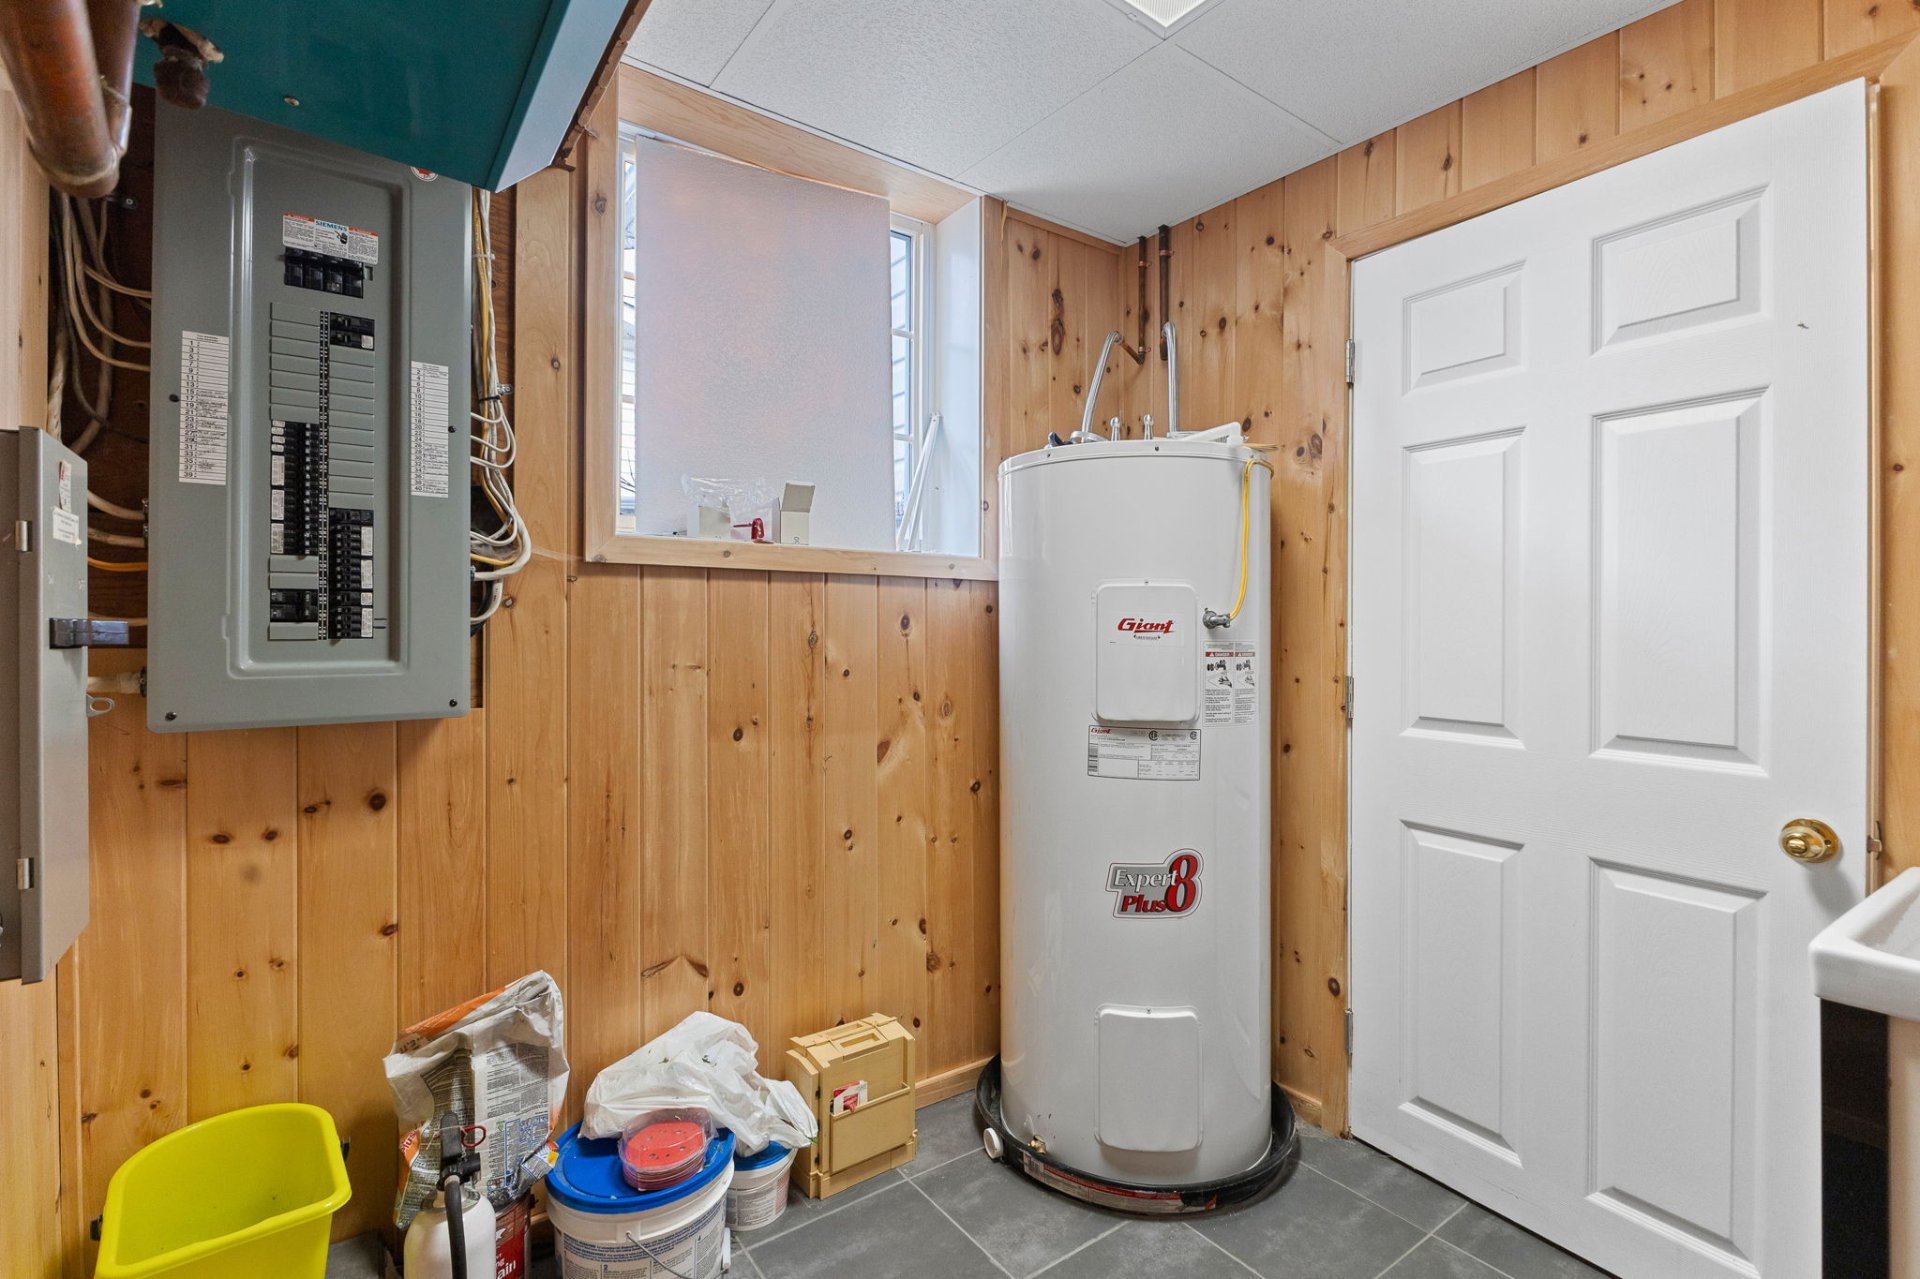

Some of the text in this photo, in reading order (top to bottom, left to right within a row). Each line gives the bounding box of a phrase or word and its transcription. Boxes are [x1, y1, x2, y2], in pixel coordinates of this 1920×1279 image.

[316, 220, 347, 232] SIEMENS
[1118, 618, 1174, 634] Giant
[1114, 869, 1178, 893] Expert
[1164, 855, 1199, 912] 8
[1120, 895, 1168, 913] Plus
